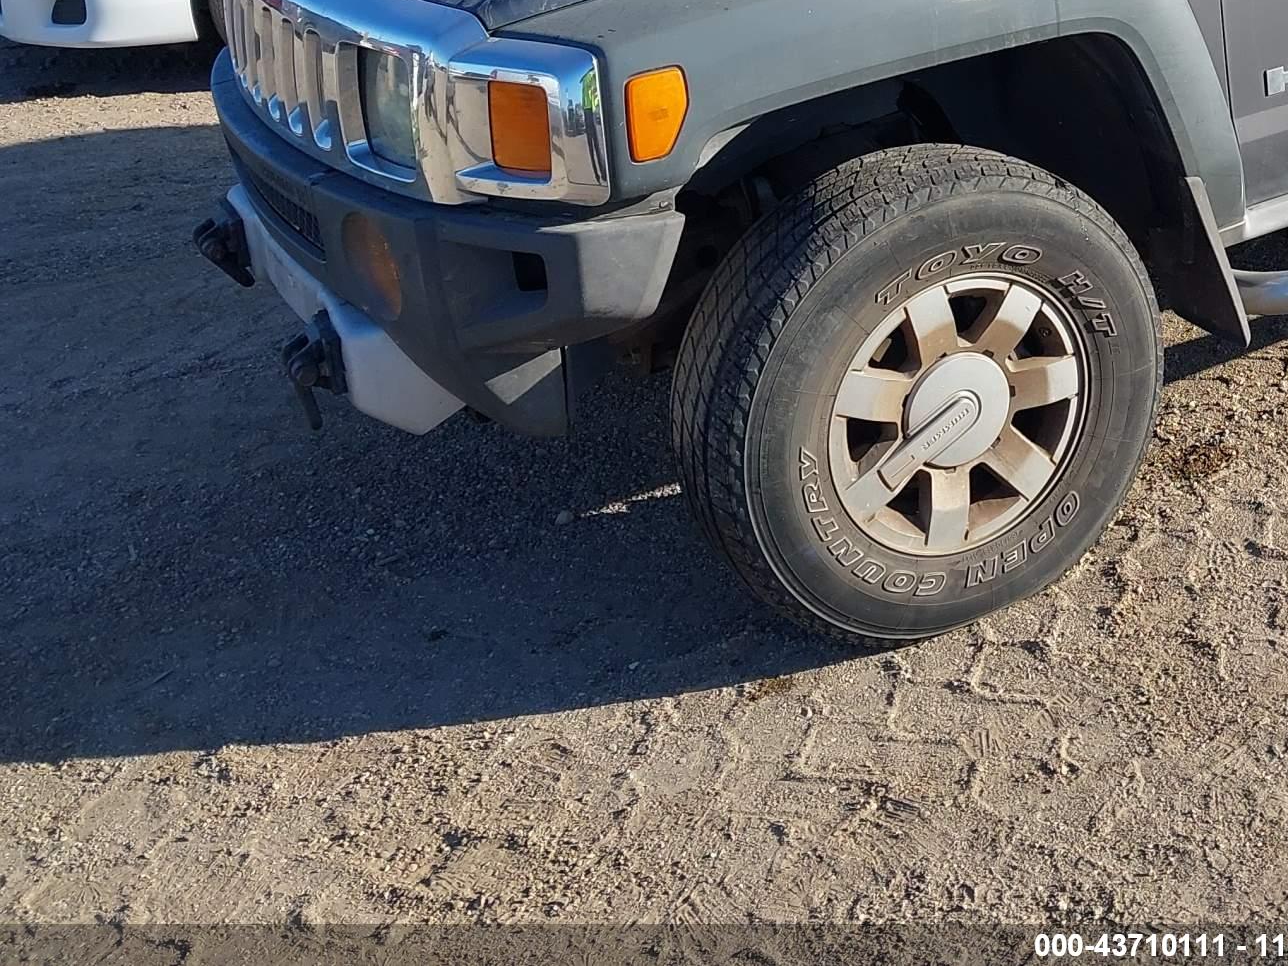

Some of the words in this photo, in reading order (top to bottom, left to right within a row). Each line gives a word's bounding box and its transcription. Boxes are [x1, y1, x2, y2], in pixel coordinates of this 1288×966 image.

[874, 242, 1043, 305] TOYO
[1056, 270, 1118, 337] H/T
[799, 445, 947, 597] COUNTRY
[965, 490, 1080, 589] OPEN
